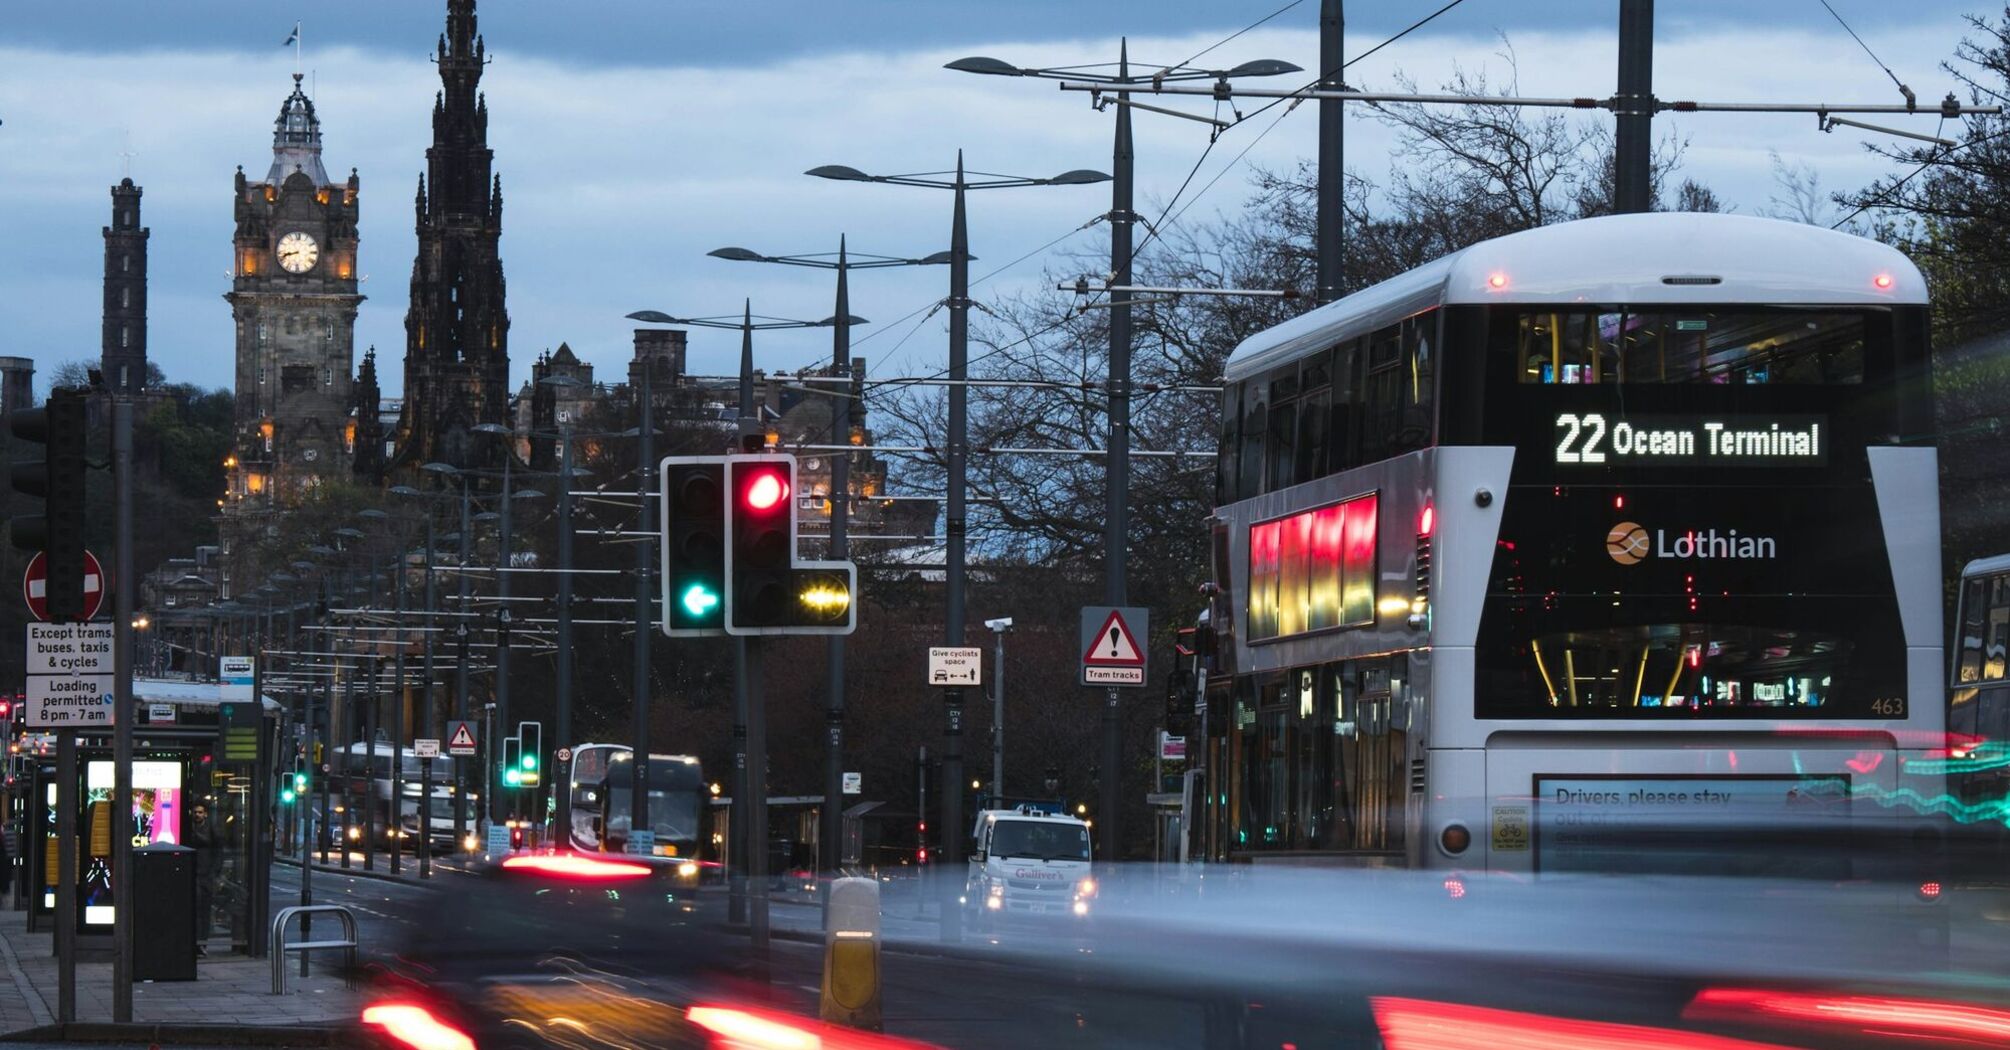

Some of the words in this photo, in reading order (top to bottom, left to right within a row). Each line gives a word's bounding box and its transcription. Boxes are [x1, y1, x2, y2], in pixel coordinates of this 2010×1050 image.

[1556, 414, 1606, 463] 22
[1613, 422, 1694, 455] Ocean
[1704, 423, 1819, 456] Terminal
[1657, 529, 1776, 558] Lothian
[32, 628, 73, 640] Except
[81, 642, 110, 653] taxis
[950, 650, 978, 658] cyclists
[48, 657, 57, 668] &
[60, 656, 98, 670] cycles
[1089, 670, 1111, 679] Tram
[1112, 671, 1140, 679] tracks
[50, 681, 97, 693] Loading
[43, 694, 103, 708] permitted
[1871, 698, 1904, 715] 463
[40, 709, 48, 720] 8
[50, 711, 70, 722] pm
[79, 709, 86, 720] 7
[88, 711, 106, 720] am
[1628, 788, 1688, 807] please
[1694, 789, 1732, 806] stay
[1555, 811, 1584, 826] out
[1015, 868, 1065, 881] Gulliver's
